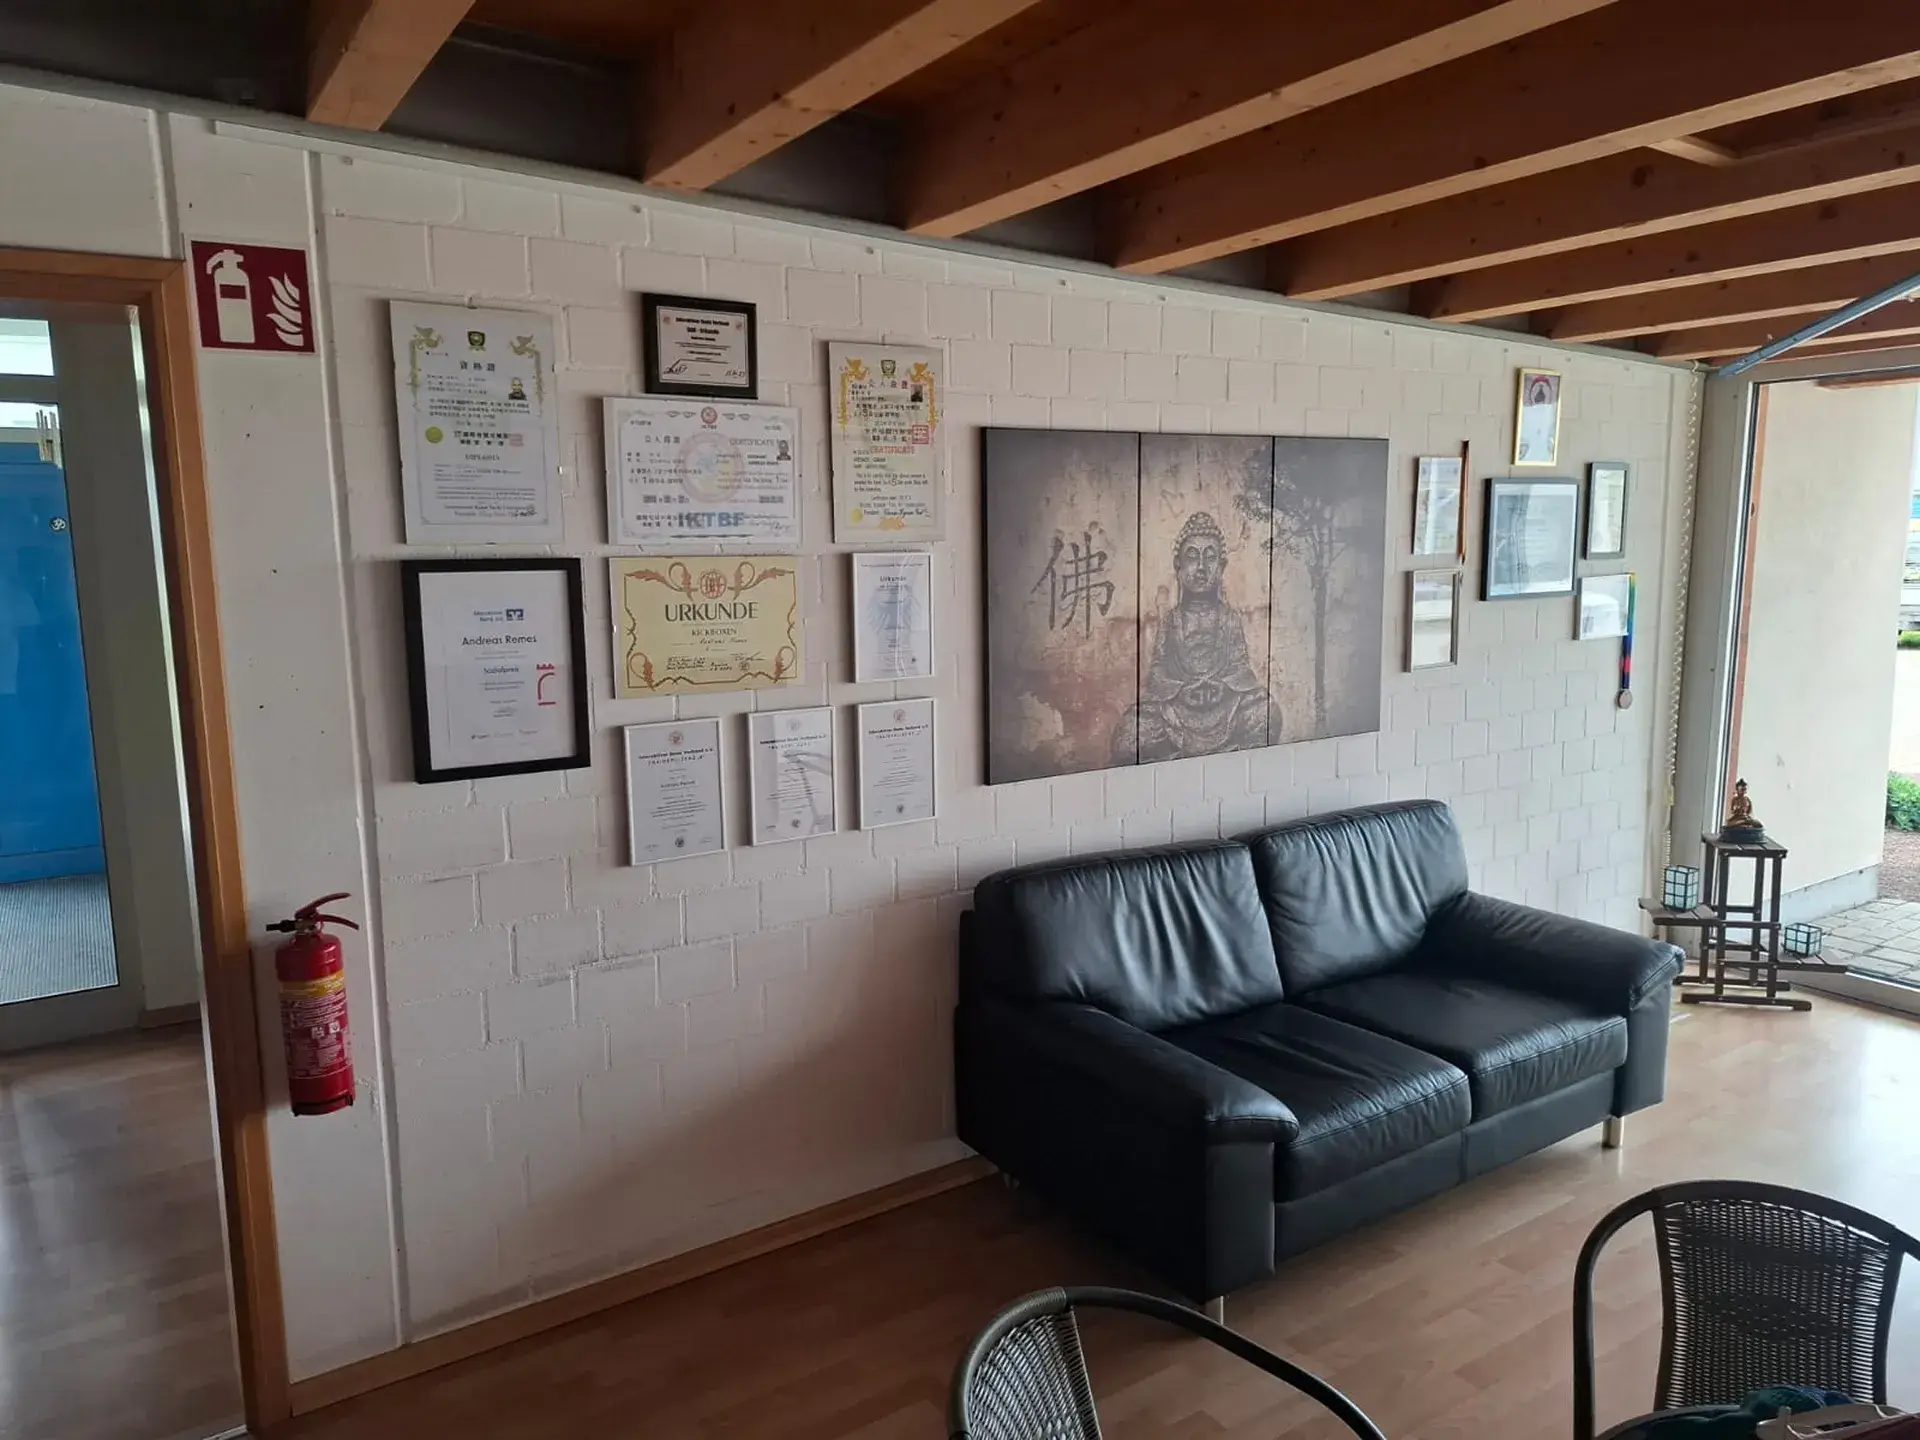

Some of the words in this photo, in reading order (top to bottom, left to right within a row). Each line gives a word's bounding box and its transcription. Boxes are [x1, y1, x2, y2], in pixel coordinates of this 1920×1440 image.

[1030, 530, 1116, 640] 佛
[664, 601, 759, 622] URKUNDE
[461, 635, 503, 646] Andreas
[505, 634, 538, 644] Remes
